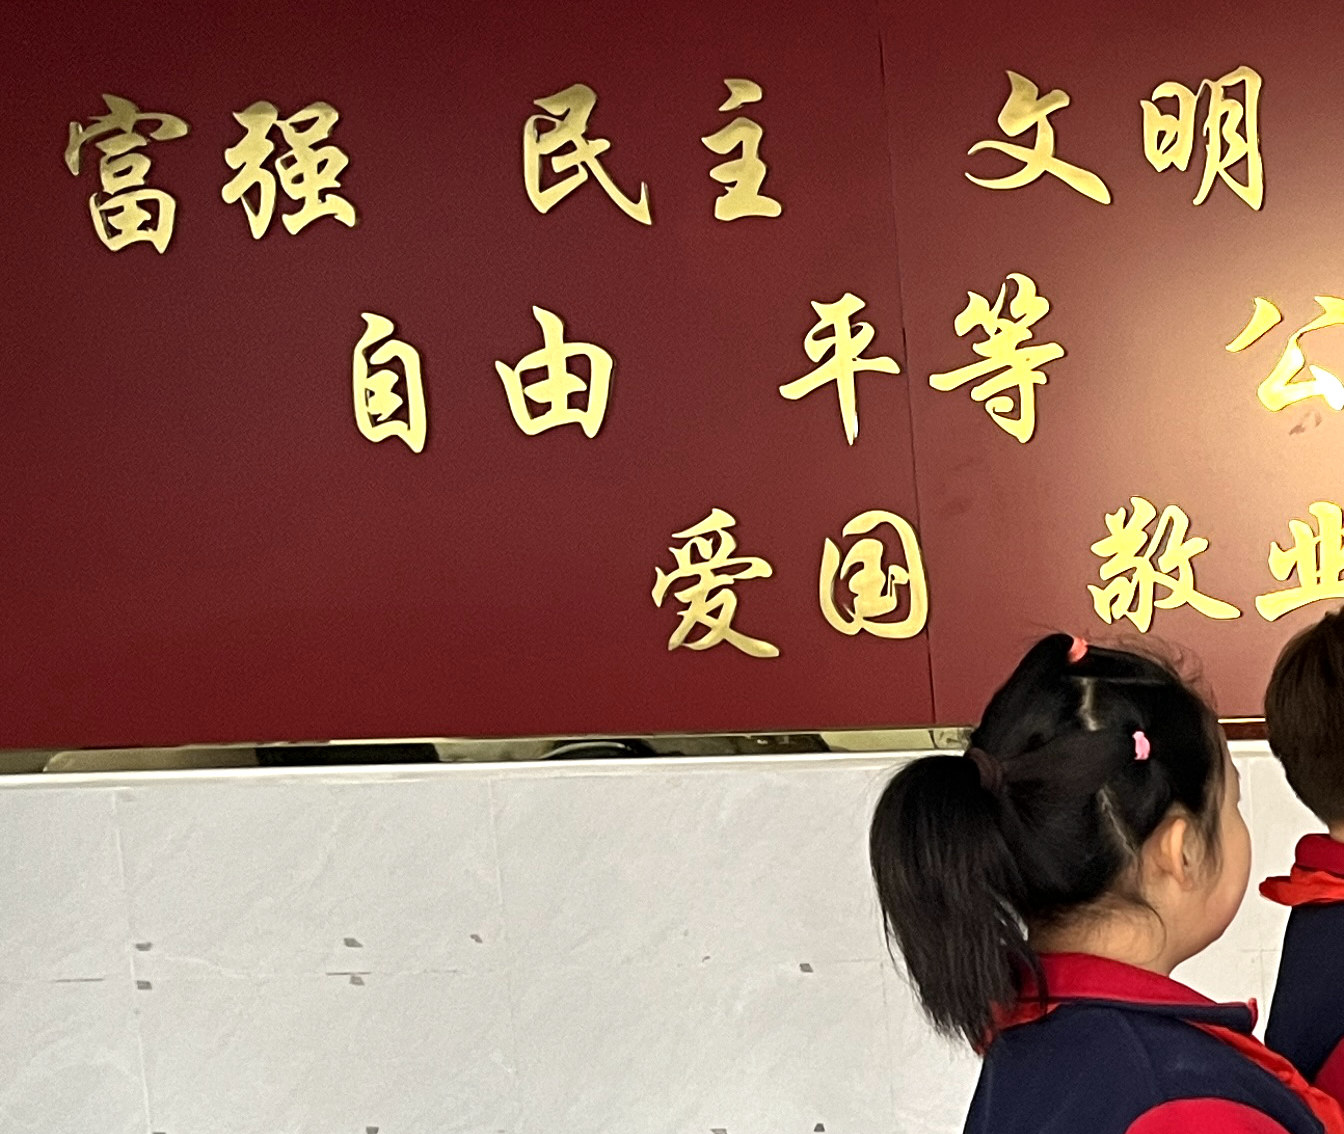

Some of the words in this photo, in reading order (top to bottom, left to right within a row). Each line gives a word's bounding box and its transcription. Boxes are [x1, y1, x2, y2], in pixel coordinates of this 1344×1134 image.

[66, 95, 357, 254] 富强
[523, 79, 783, 226] 民主
[965, 66, 1264, 211] 文明
[352, 305, 614, 454] 自由
[779, 272, 1065, 446] 平等
[651, 507, 929, 658] 爱国
